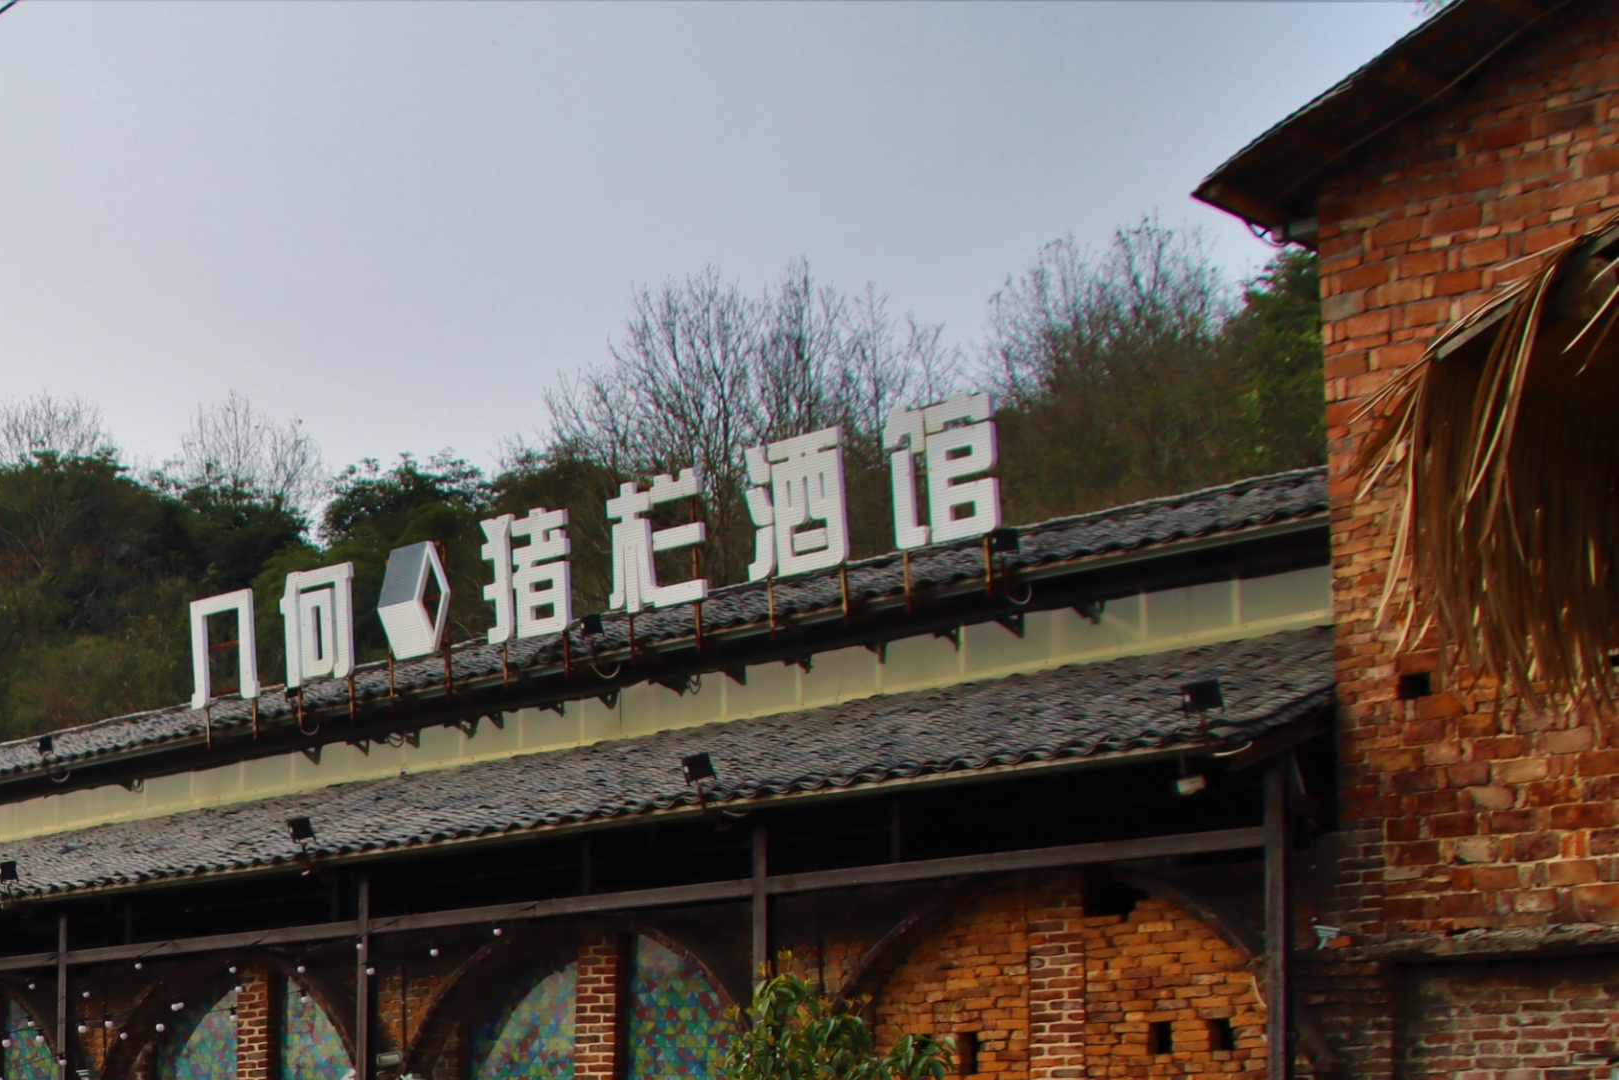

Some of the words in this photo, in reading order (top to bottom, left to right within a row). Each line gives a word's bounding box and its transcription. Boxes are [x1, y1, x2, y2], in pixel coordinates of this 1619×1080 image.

[190, 561, 356, 710] 几何
[480, 392, 1002, 645] 猪栏酒馆
